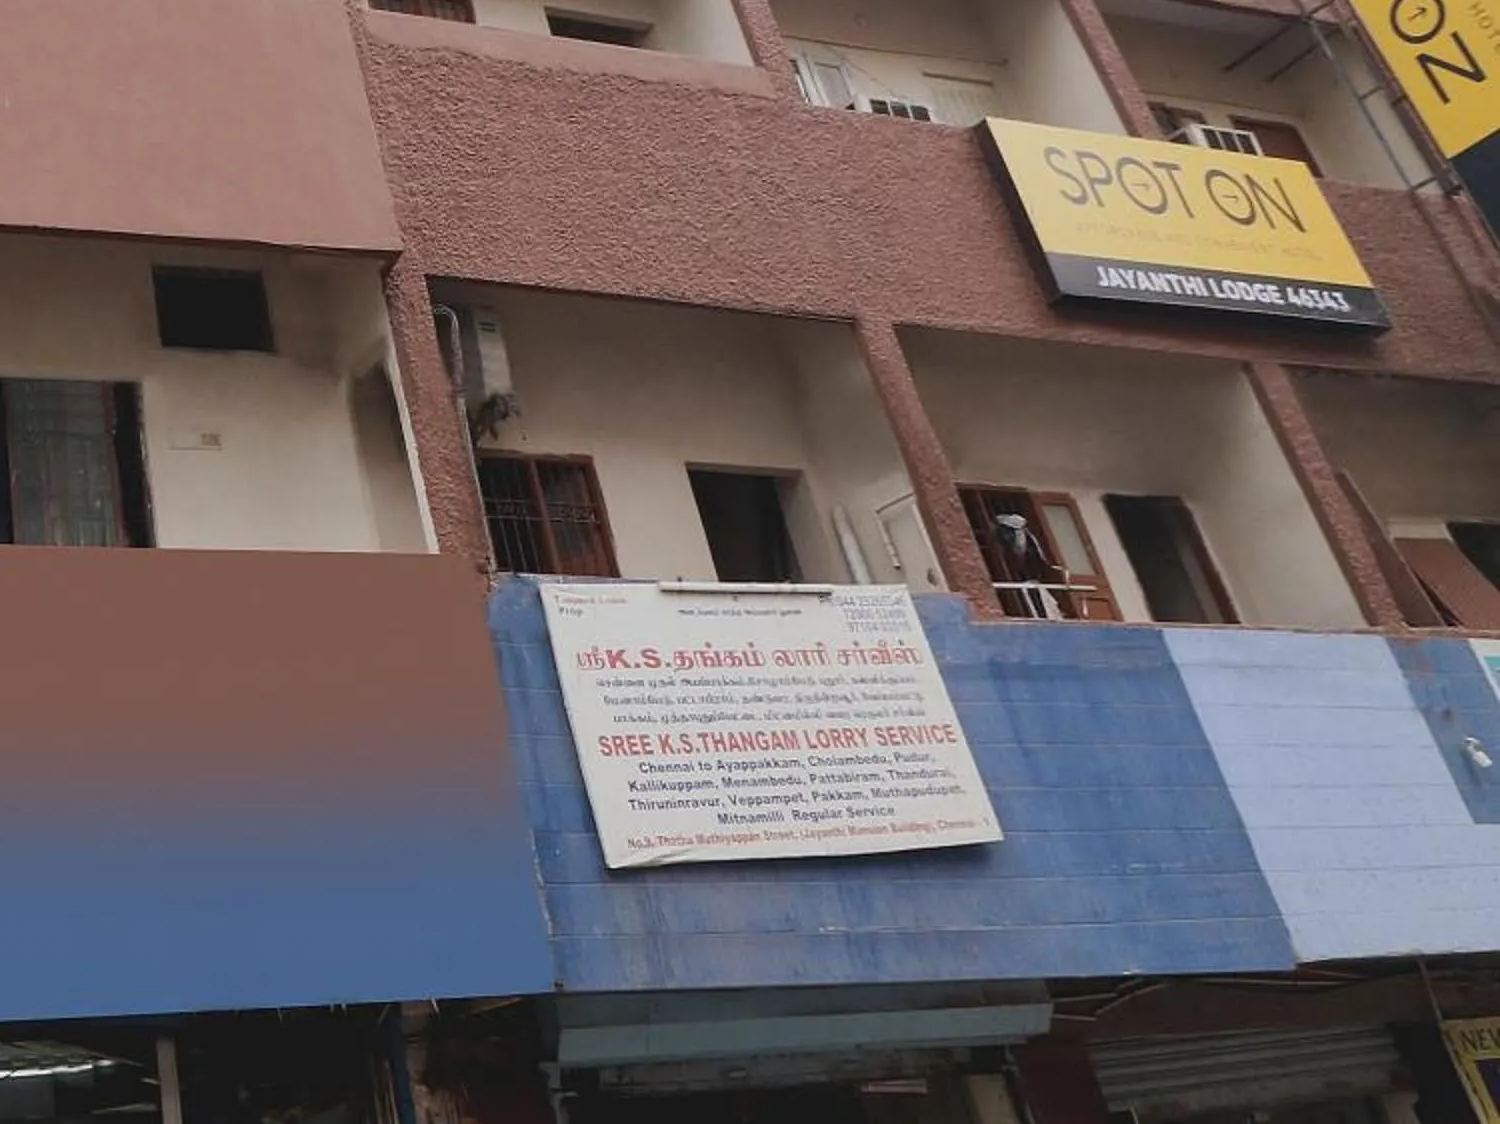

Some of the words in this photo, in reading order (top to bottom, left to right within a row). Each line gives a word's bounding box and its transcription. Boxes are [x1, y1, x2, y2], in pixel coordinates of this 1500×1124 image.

[1043, 146, 1196, 219] SPOT
[1205, 169, 1307, 233] ON
[1096, 266, 1209, 297] JAYANTHI
[1208, 278, 1284, 304] LODGE
[598, 734, 655, 757] SREE
[657, 730, 800, 756] K.S.THANGAM
[804, 726, 869, 750] LORRY
[876, 724, 958, 746] SERVICE
[639, 760, 695, 774] Chennai
[698, 762, 713, 772] to
[791, 807, 842, 822] Regular
[846, 806, 895, 818] Service
